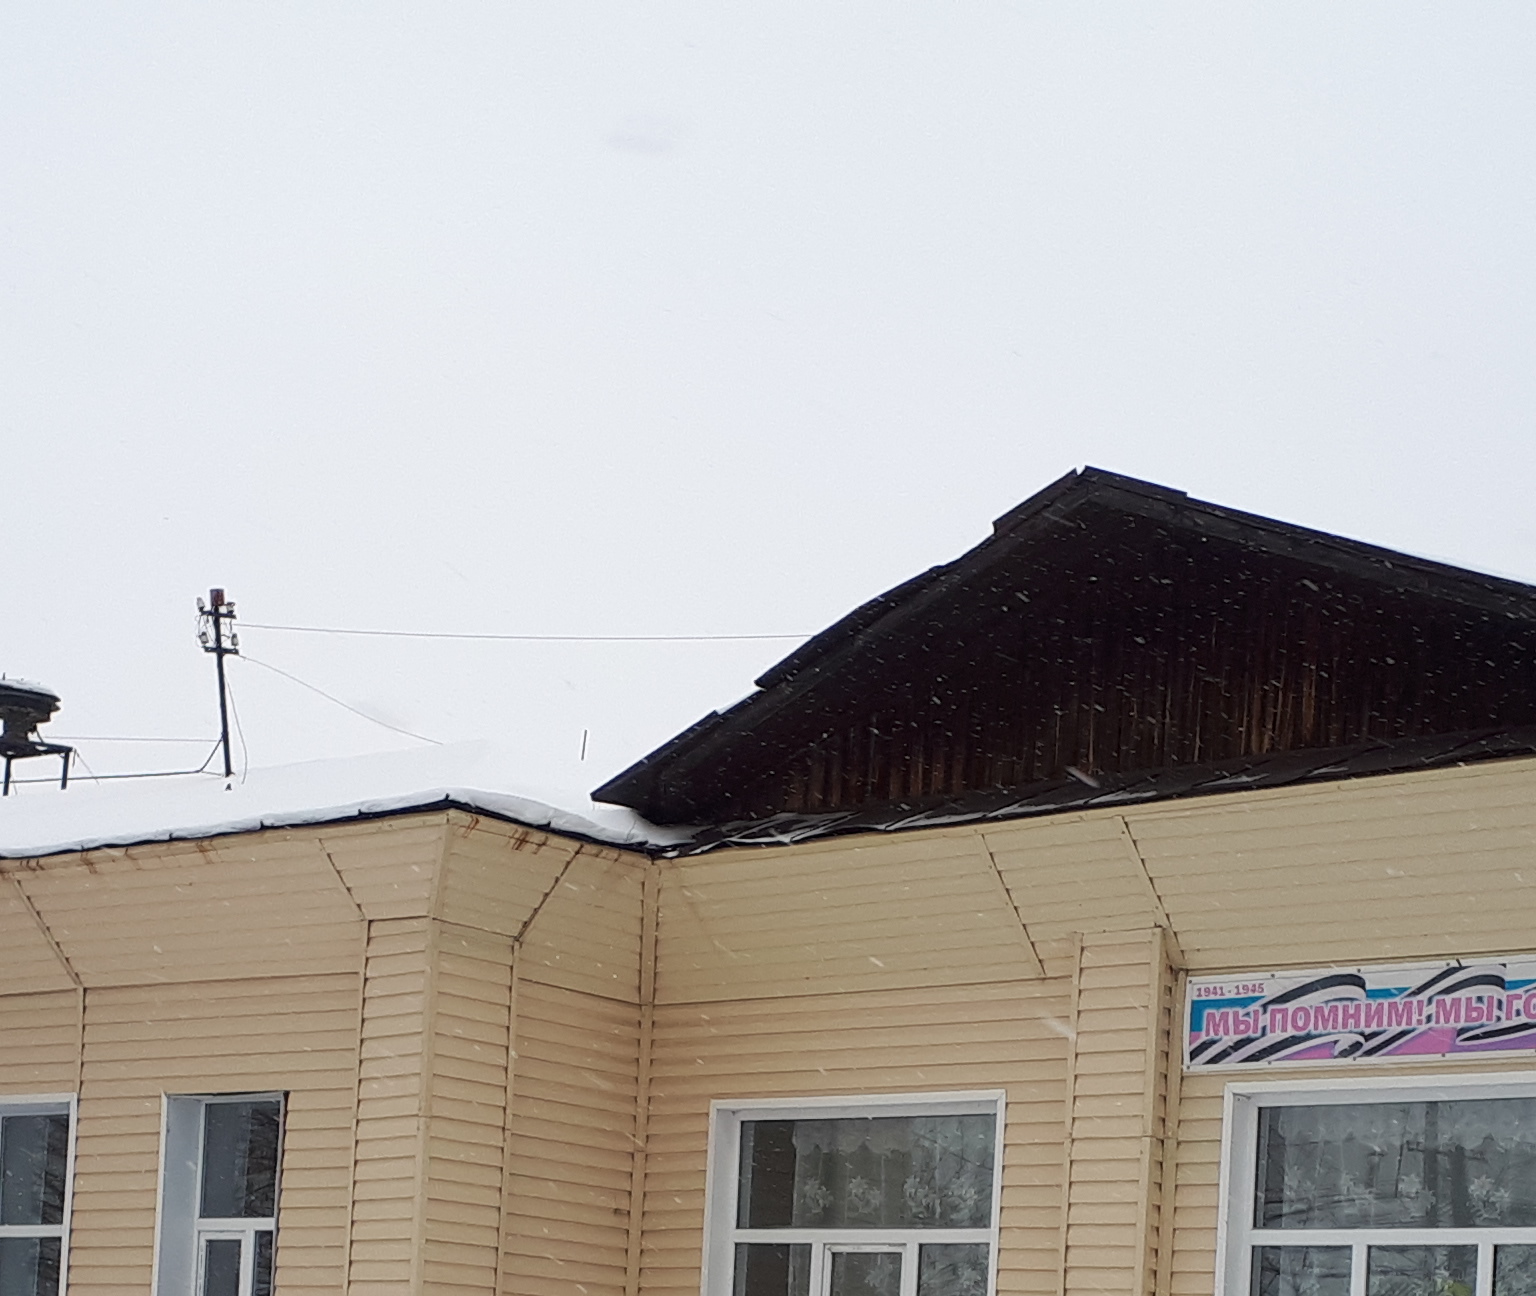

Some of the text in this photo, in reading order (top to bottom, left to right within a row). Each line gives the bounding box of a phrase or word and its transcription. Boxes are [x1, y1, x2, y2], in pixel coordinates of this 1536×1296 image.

[1204, 1008, 1260, 1037] МЫ
[1268, 999, 1425, 1034] ПОМНИМ!
[1434, 995, 1495, 1026] МЫ
